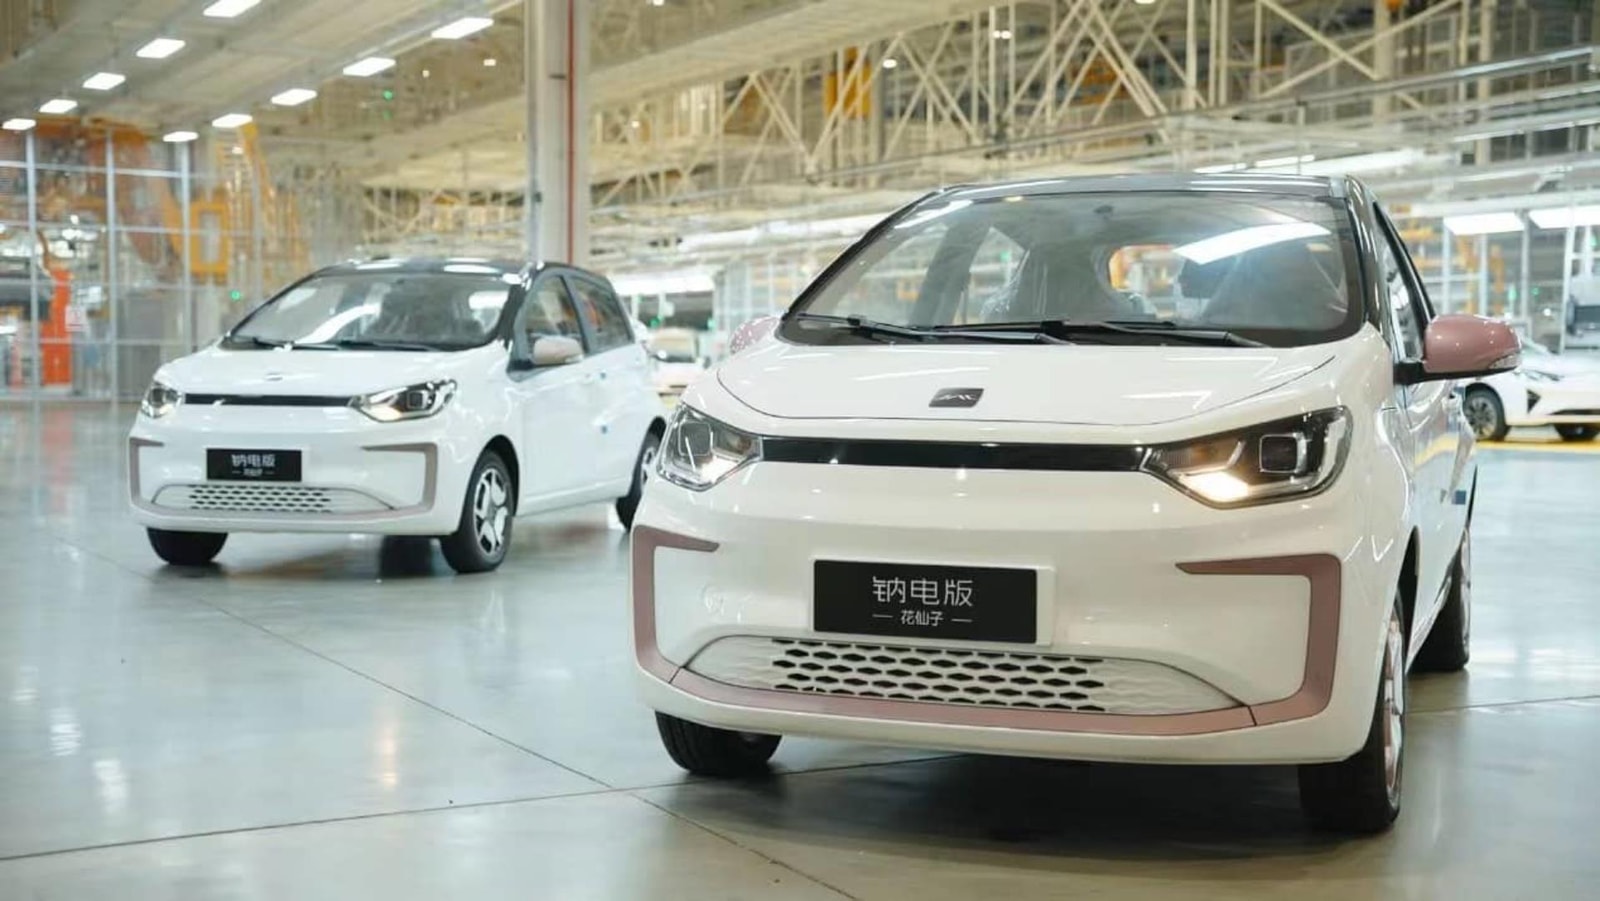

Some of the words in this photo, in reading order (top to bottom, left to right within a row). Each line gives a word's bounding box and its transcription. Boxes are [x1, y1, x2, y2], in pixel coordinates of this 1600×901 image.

[872, 576, 973, 607] 钠电版
[901, 610, 944, 626] 花仙子
